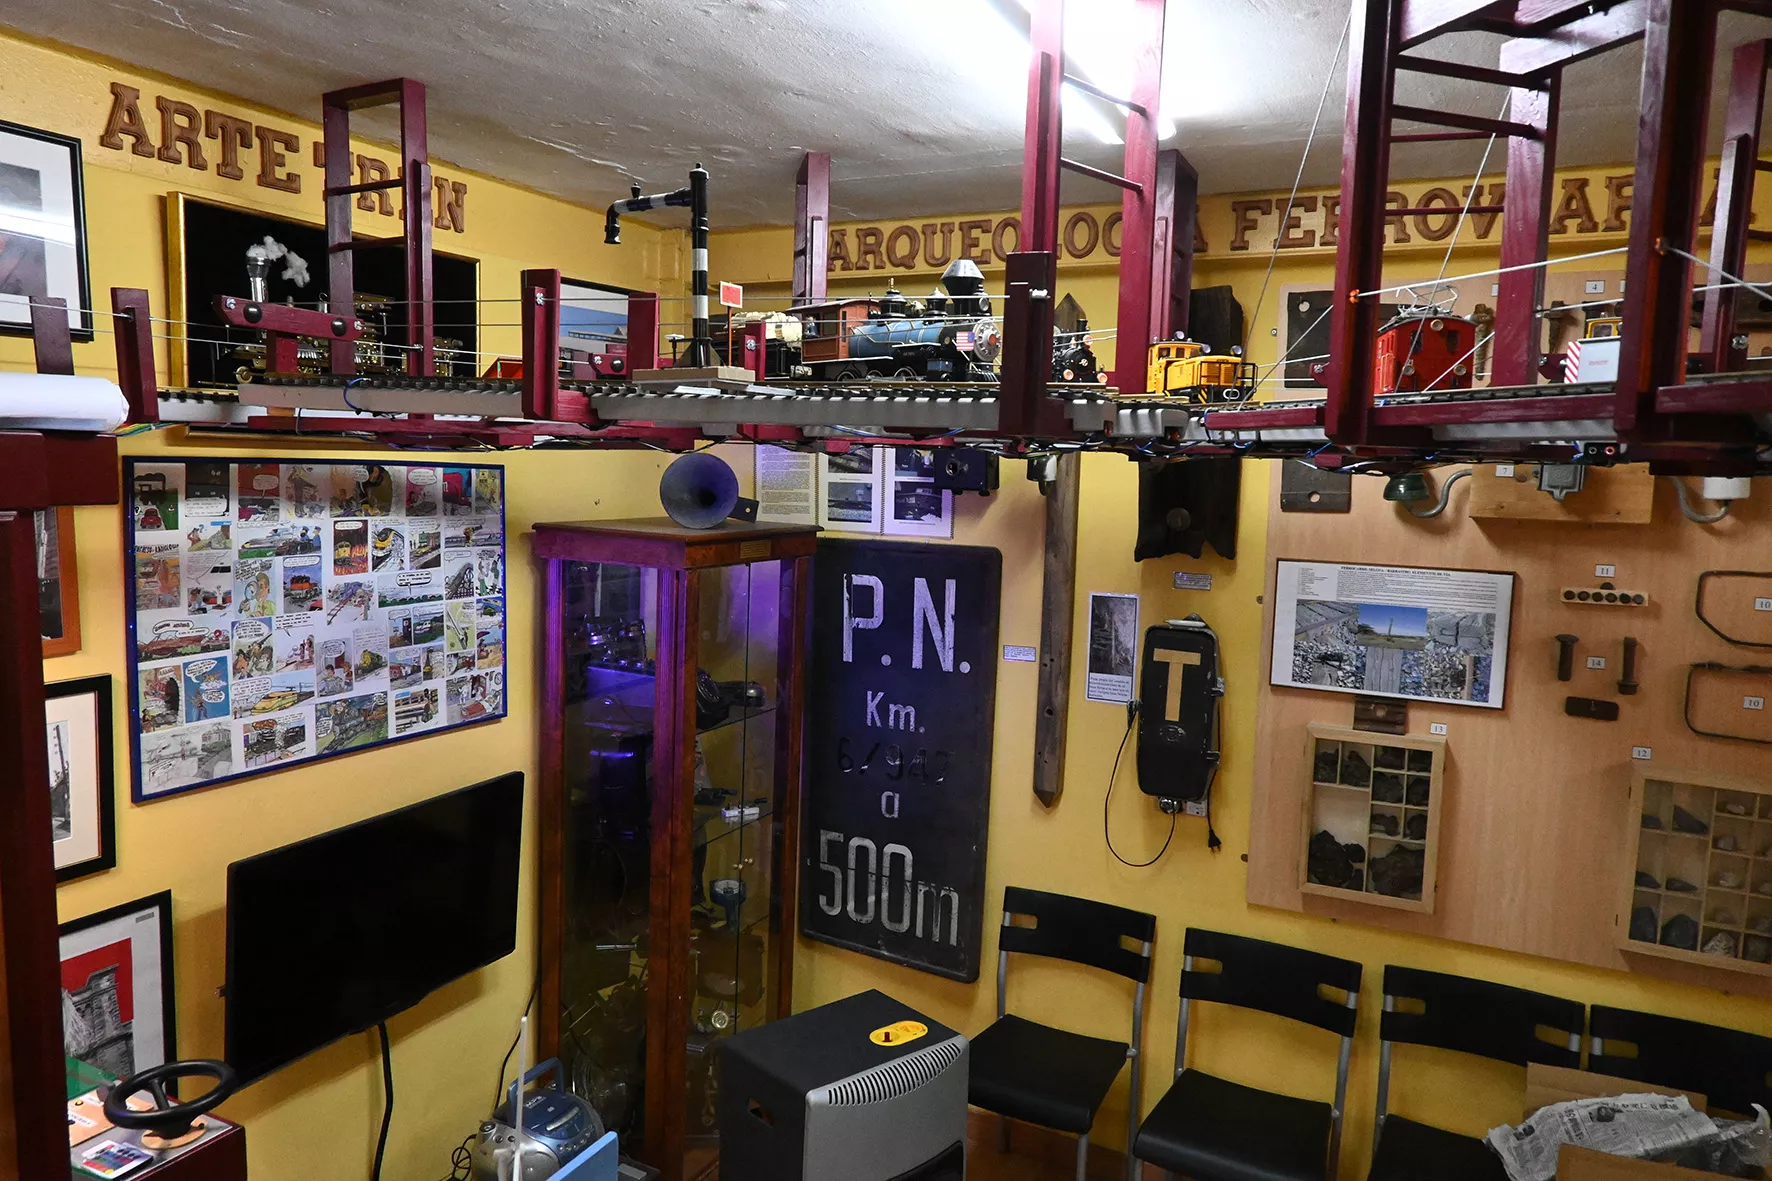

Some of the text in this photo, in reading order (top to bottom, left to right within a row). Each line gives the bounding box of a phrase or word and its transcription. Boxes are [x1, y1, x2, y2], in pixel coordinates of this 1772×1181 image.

[100, 82, 468, 234] ARTE RN
[866, 690, 925, 733] Km.
[1153, 648, 1201, 722] T
[880, 791, 900, 819] a
